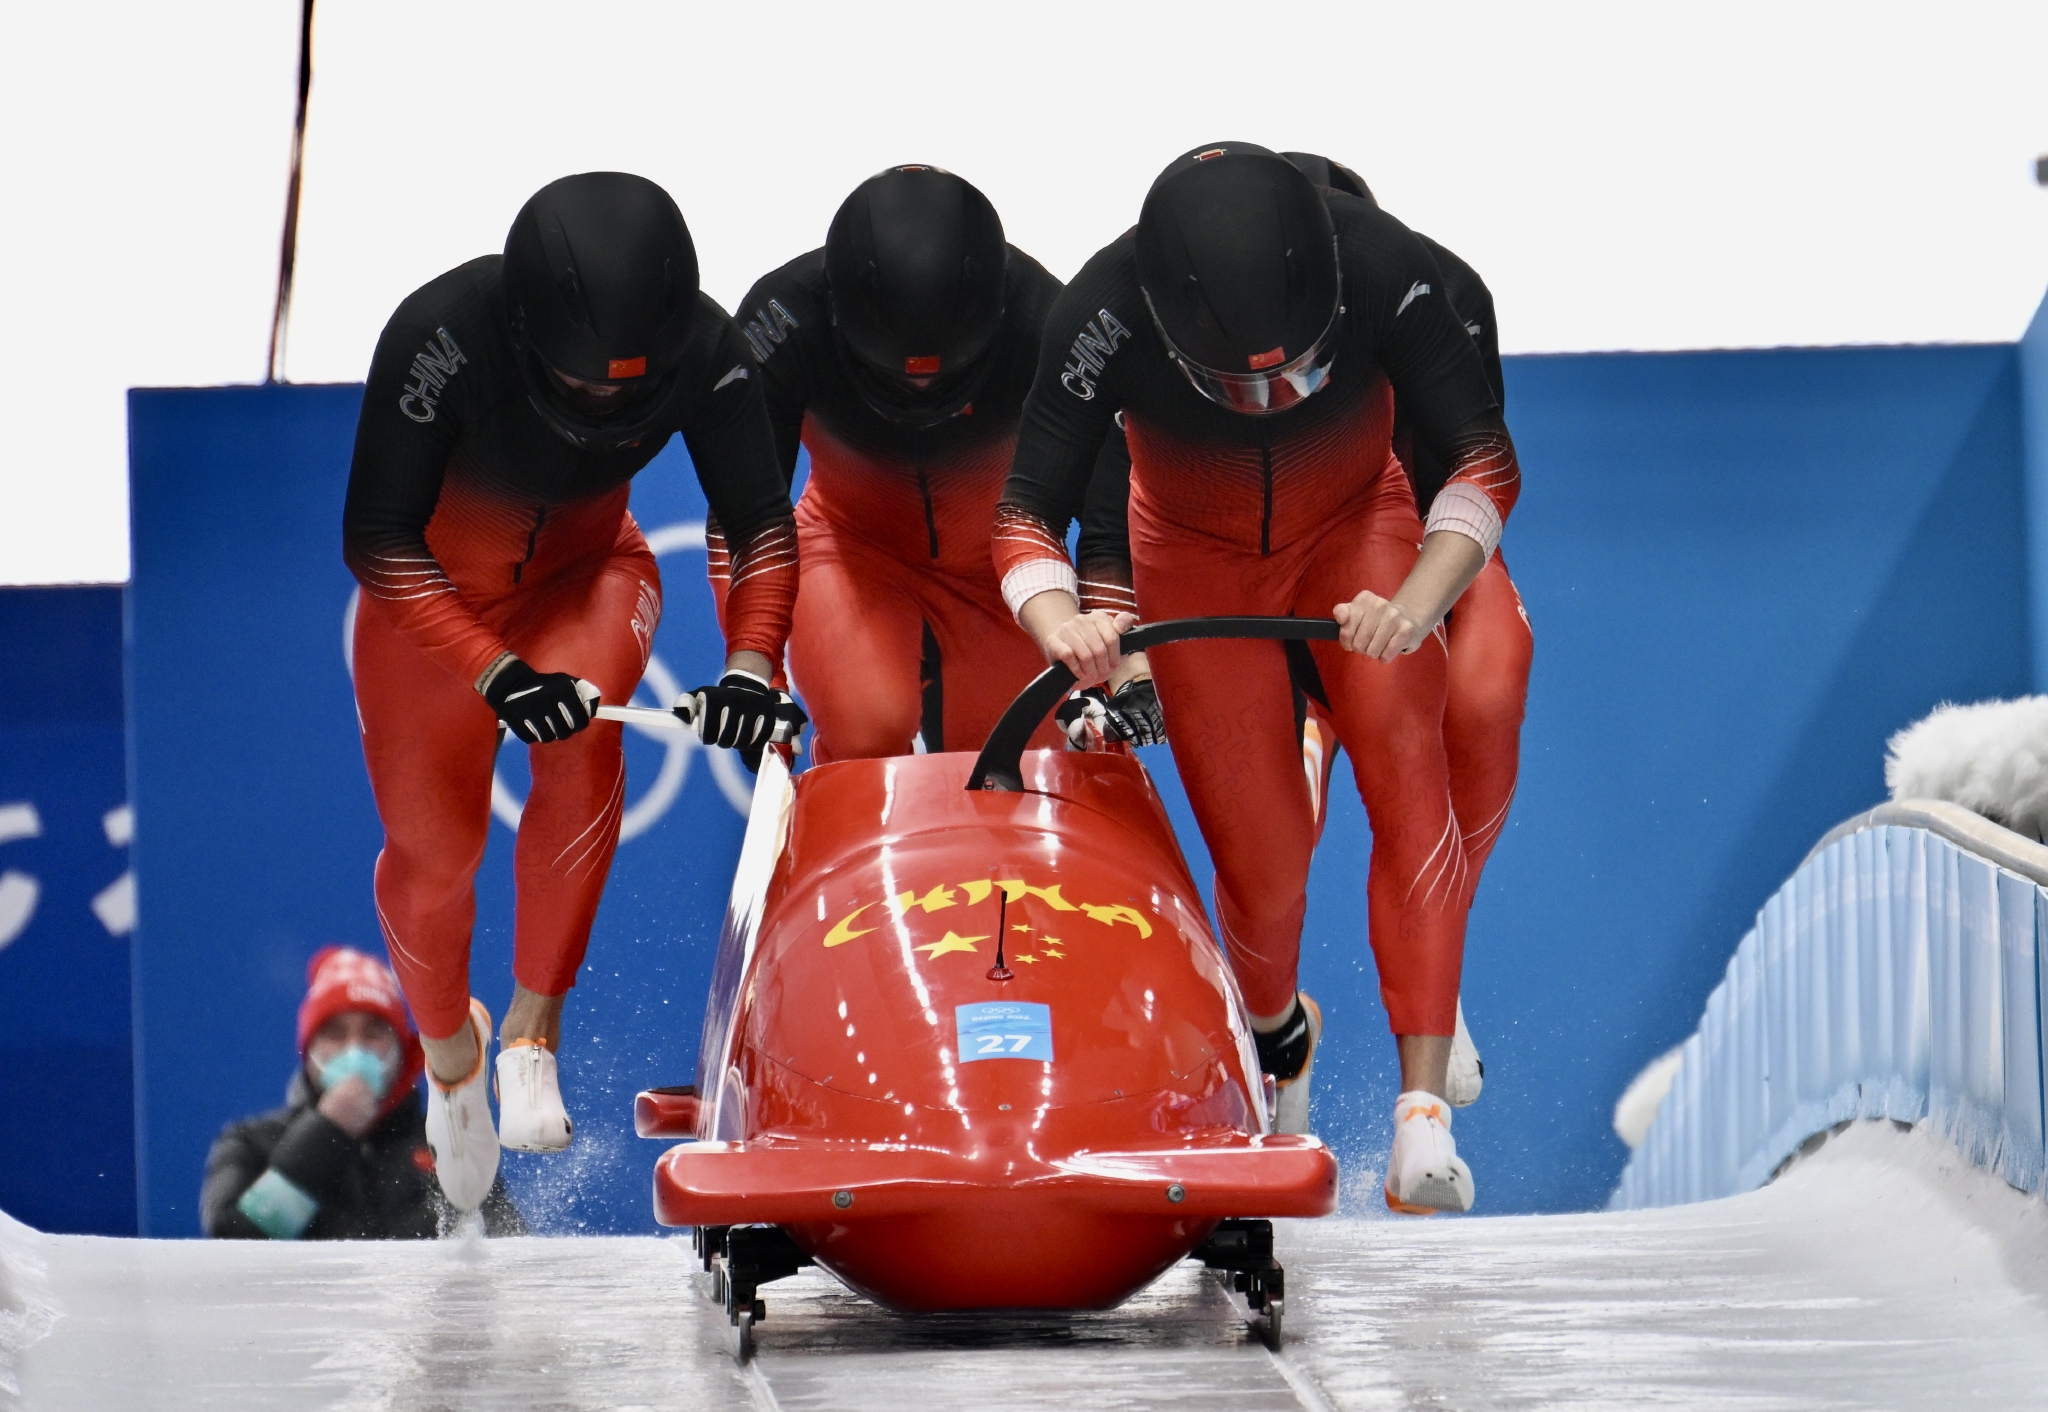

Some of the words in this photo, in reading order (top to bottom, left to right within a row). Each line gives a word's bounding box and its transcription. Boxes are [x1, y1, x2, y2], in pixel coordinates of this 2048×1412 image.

[742, 299, 799, 363] INA
[1061, 308, 1132, 401] CHINA
[399, 327, 468, 423] CHINA
[823, 879, 1153, 948] CHINA
[976, 1034, 1032, 1054] 27
